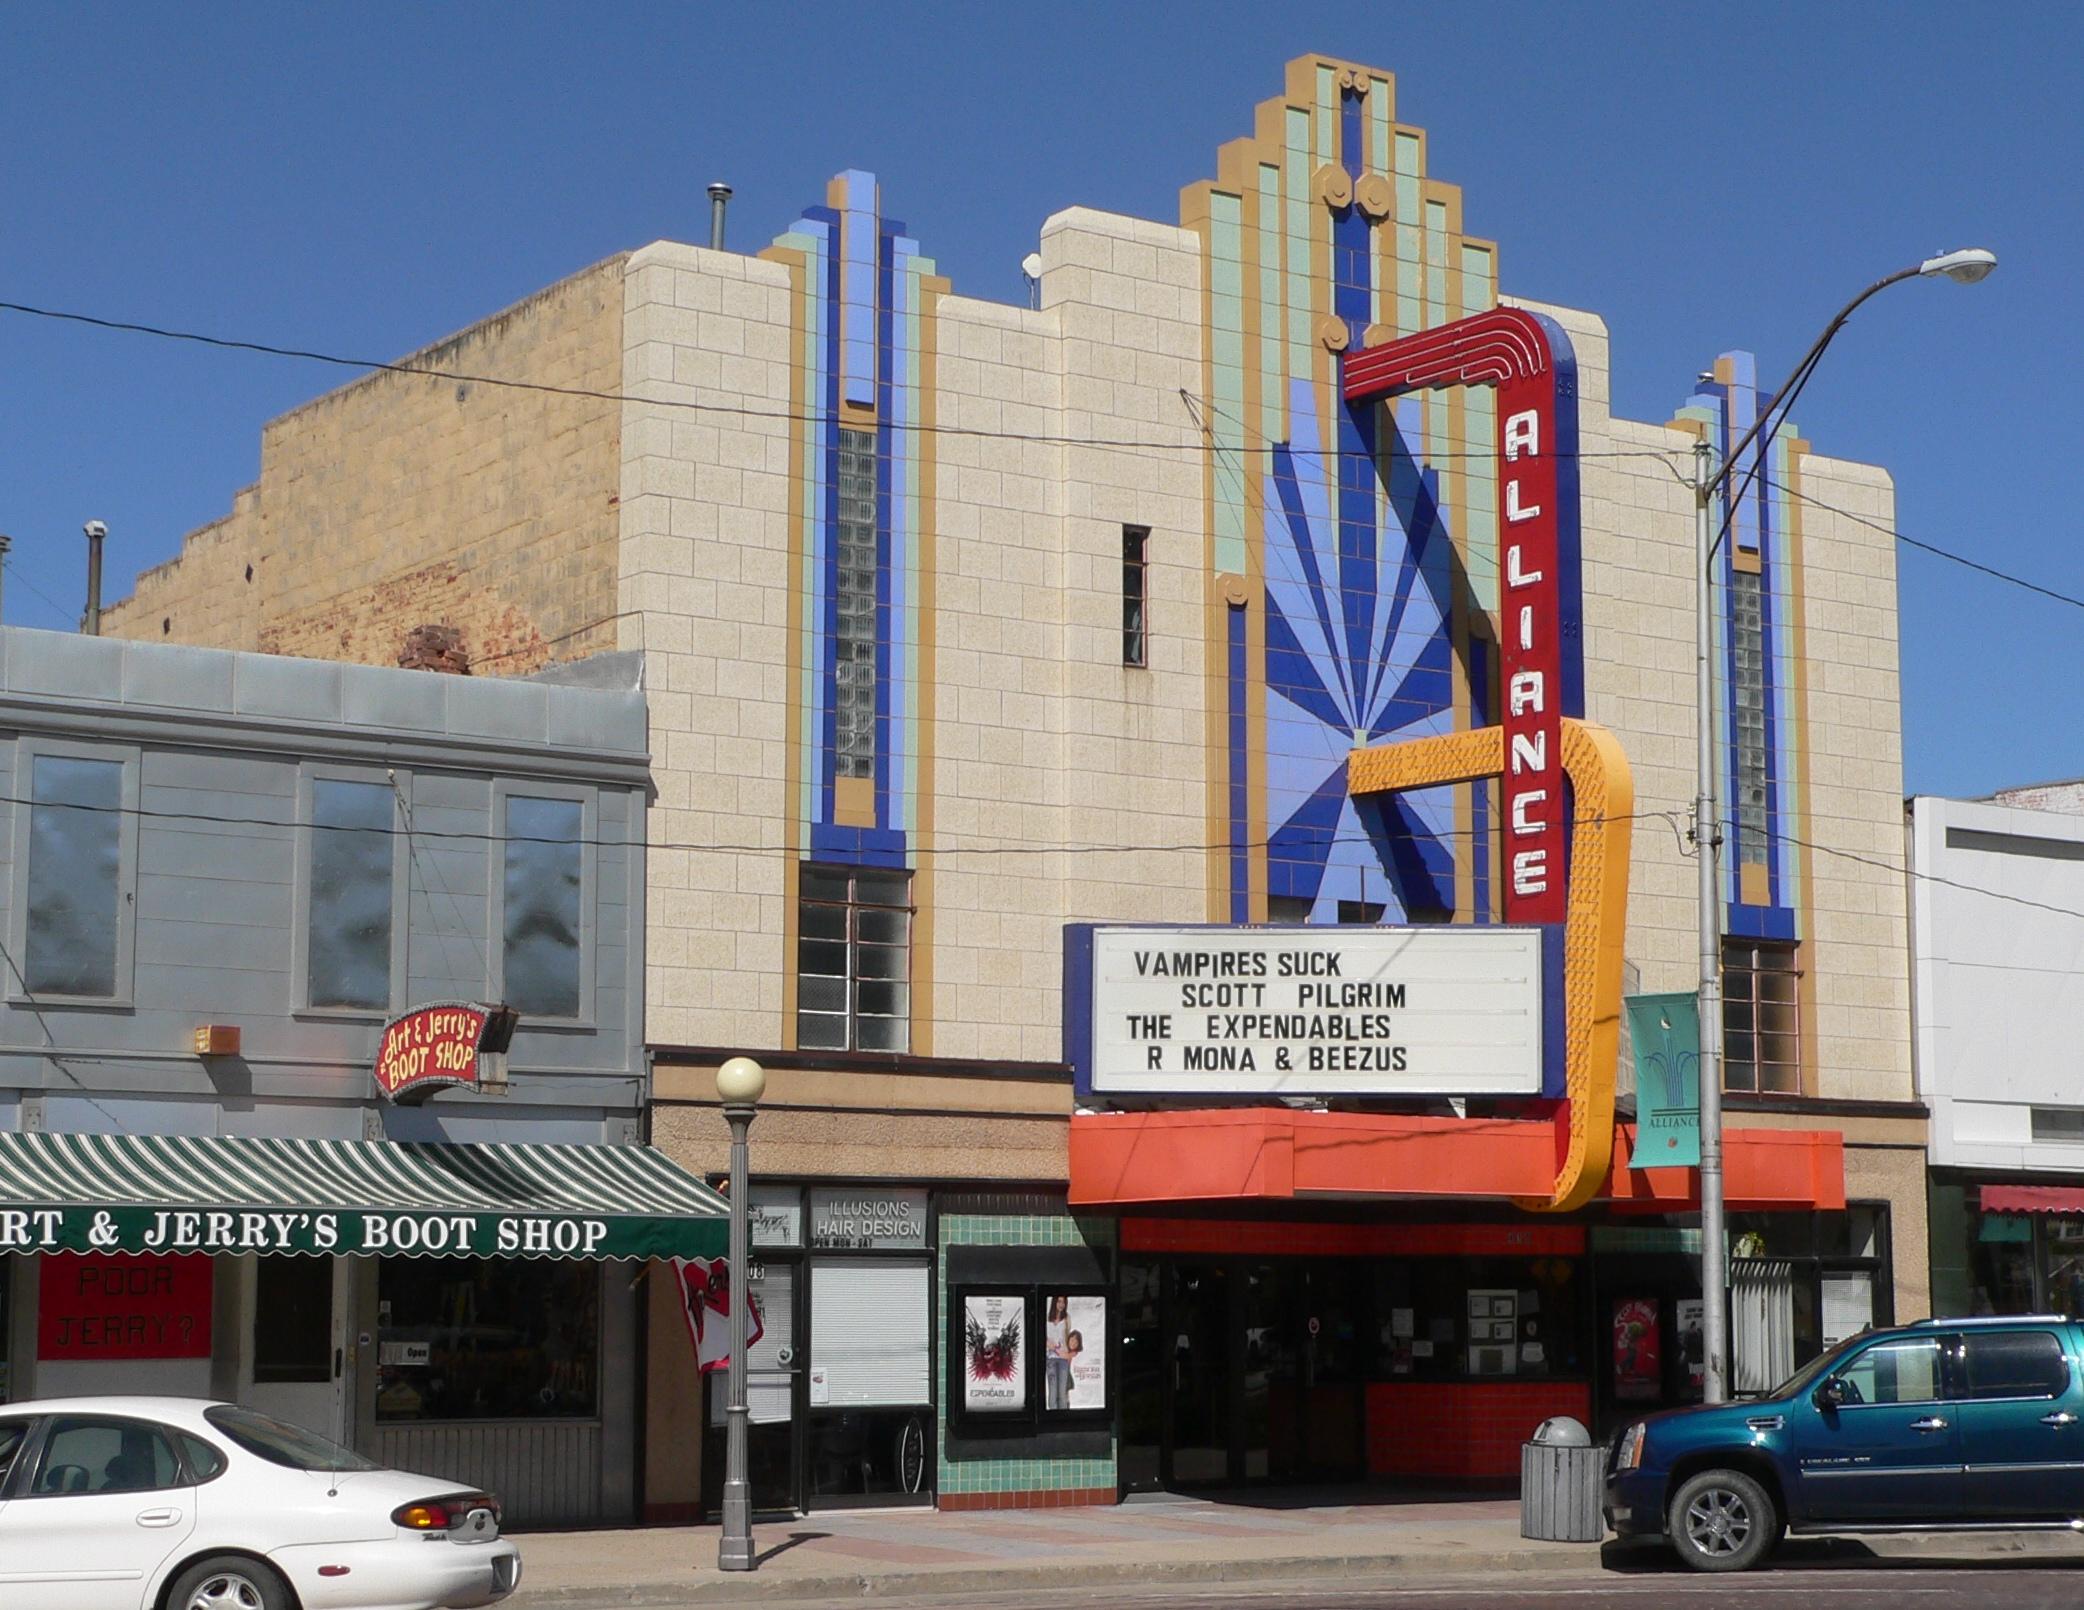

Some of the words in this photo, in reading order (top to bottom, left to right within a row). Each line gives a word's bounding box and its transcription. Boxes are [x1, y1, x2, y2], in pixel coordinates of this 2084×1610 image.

[1505, 409, 1547, 895] ALLIANCE
[1134, 951, 1267, 978] VAMPIRES
[1277, 951, 1341, 977] SUCK
[1182, 983, 1266, 1008] SCOTT
[1299, 983, 1406, 1008] PILGRIM
[385, 1021, 411, 1064] Art
[414, 1016, 422, 1044] &
[426, 1011, 478, 1043] Jerry's
[1126, 1015, 1172, 1039] THE
[1206, 1015, 1391, 1041] EXPENDABLES
[388, 1046, 430, 1090] BOOT
[436, 1041, 474, 1071] SHOP
[1147, 1046, 1163, 1070] R
[1183, 1046, 1256, 1071] MONA
[1275, 1047, 1294, 1071] &
[1309, 1046, 1407, 1071] BEEZUS
[1650, 1116, 1700, 1129] ALLIANC
[829, 1201, 910, 1217] ILLUSIONS
[88, 1210, 119, 1246] &
[144, 1211, 338, 1247] JERRY'S
[361, 1215, 477, 1250] BOOT
[497, 1218, 607, 1252] SHOP
[817, 1220, 855, 1236] HAIR
[862, 1220, 921, 1236] DESIGN
[78, 1266, 174, 1296] POOR
[407, 1347, 427, 1358] Open
